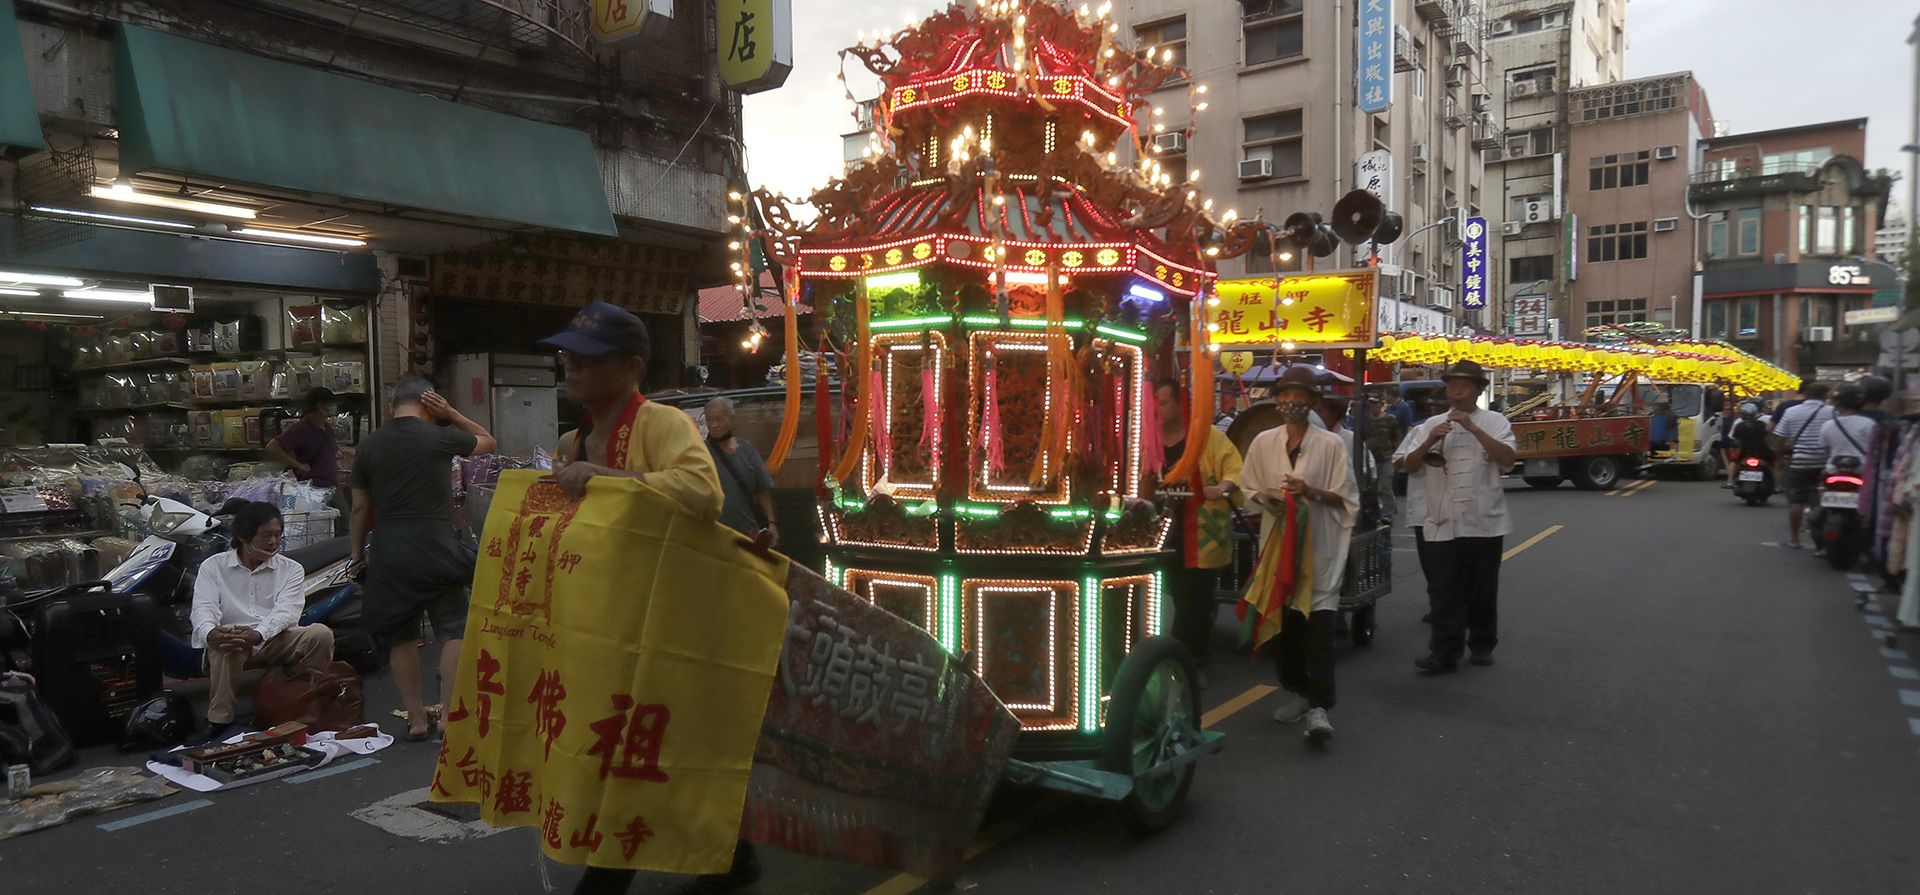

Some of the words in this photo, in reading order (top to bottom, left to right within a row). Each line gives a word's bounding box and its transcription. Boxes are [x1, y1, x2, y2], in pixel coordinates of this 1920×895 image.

[1518, 298, 1542, 315] 24
[1217, 306, 1335, 336] 龍山寺
